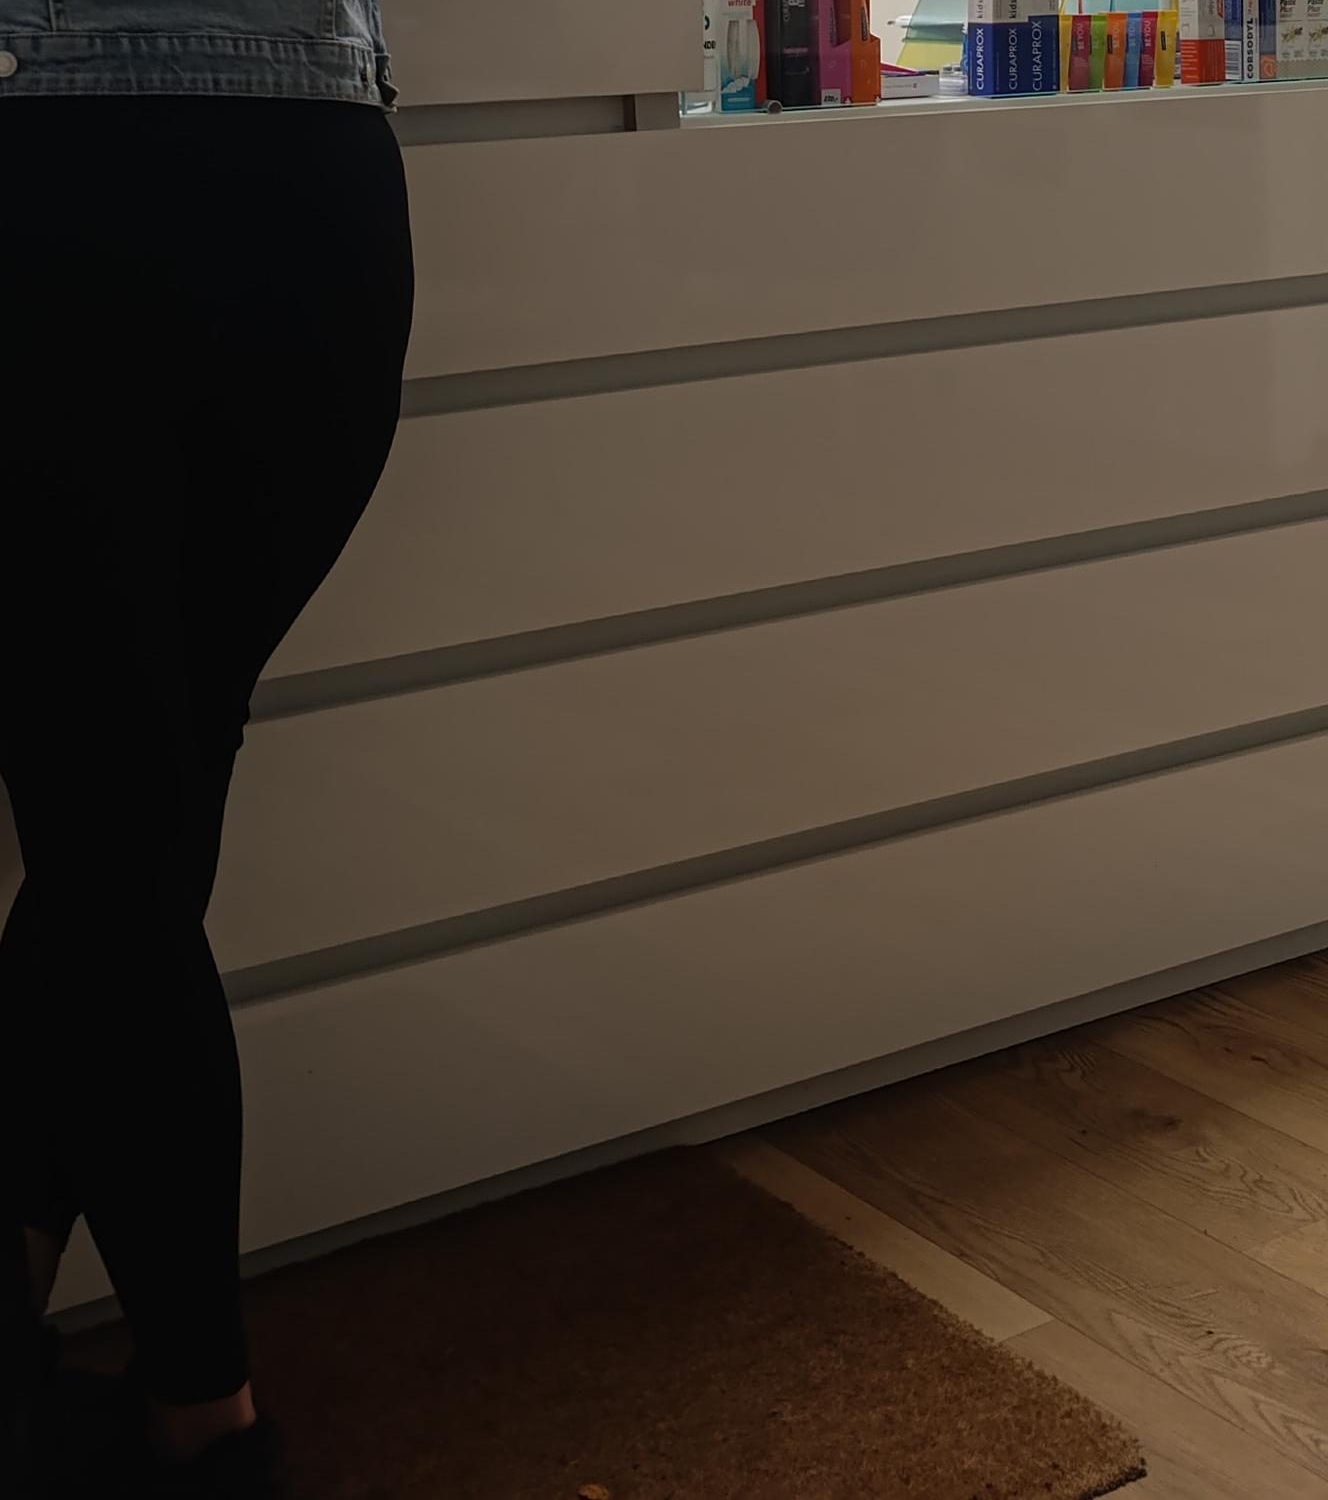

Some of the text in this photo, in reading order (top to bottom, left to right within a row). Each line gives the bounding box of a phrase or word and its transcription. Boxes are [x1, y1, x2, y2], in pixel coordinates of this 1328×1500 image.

[1009, 0, 1017, 19] kids
[976, 27, 985, 90] CURAPROX
[1009, 27, 1018, 90] CURAPROX
[1032, 20, 1042, 91] CURAPROX
[1246, 18, 1254, 79] CORSODYL
